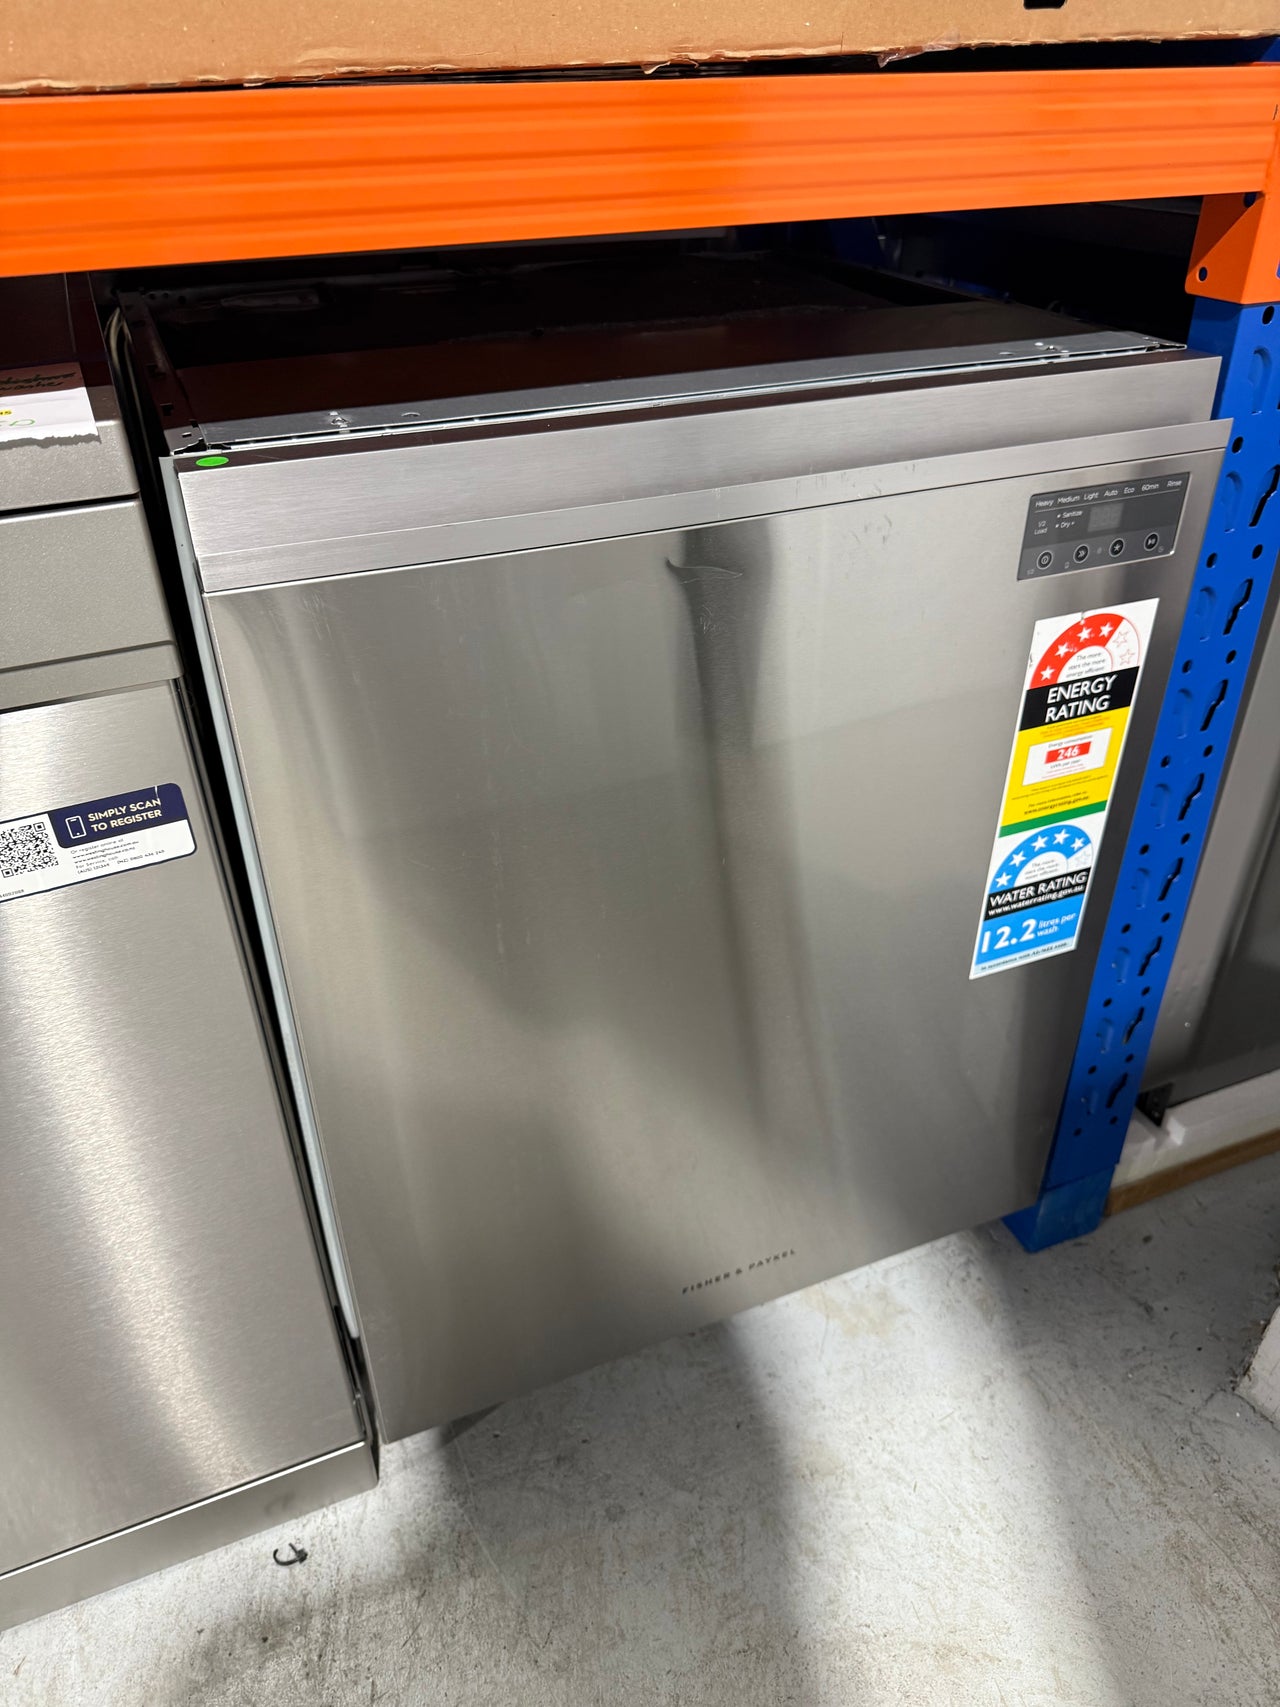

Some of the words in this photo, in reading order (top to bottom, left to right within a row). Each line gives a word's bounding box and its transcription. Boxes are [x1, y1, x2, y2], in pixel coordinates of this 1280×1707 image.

[1035, 499, 1054, 509] Heavy
[1057, 494, 1080, 504] Medium
[1083, 492, 1099, 501] Light
[1104, 489, 1118, 497] Auto
[1123, 486, 1135, 495] Eco
[1141, 483, 1159, 492] 60min
[1167, 479, 1183, 488] Rinse
[1034, 527, 1048, 535] Load
[1047, 674, 1118, 704] ENERGY
[1045, 695, 1112, 723] RATING
[1056, 745, 1081, 761] 246
[88, 805, 127, 822] SIMPLY
[129, 798, 162, 813] SCAN
[90, 821, 109, 833] TO
[110, 809, 162, 828] REGISTER
[988, 885, 1085, 916] www.waterrating.gov.au
[989, 886, 1037, 908] WATER
[1037, 871, 1089, 895] RATING
[1037, 925, 1059, 937] wash
[1038, 917, 1060, 929] litres
[1061, 912, 1076, 925] per
[981, 918, 1038, 954] 12.2
[682, 1272, 731, 1295] FISHER
[749, 1248, 795, 1271] PAYKEL
